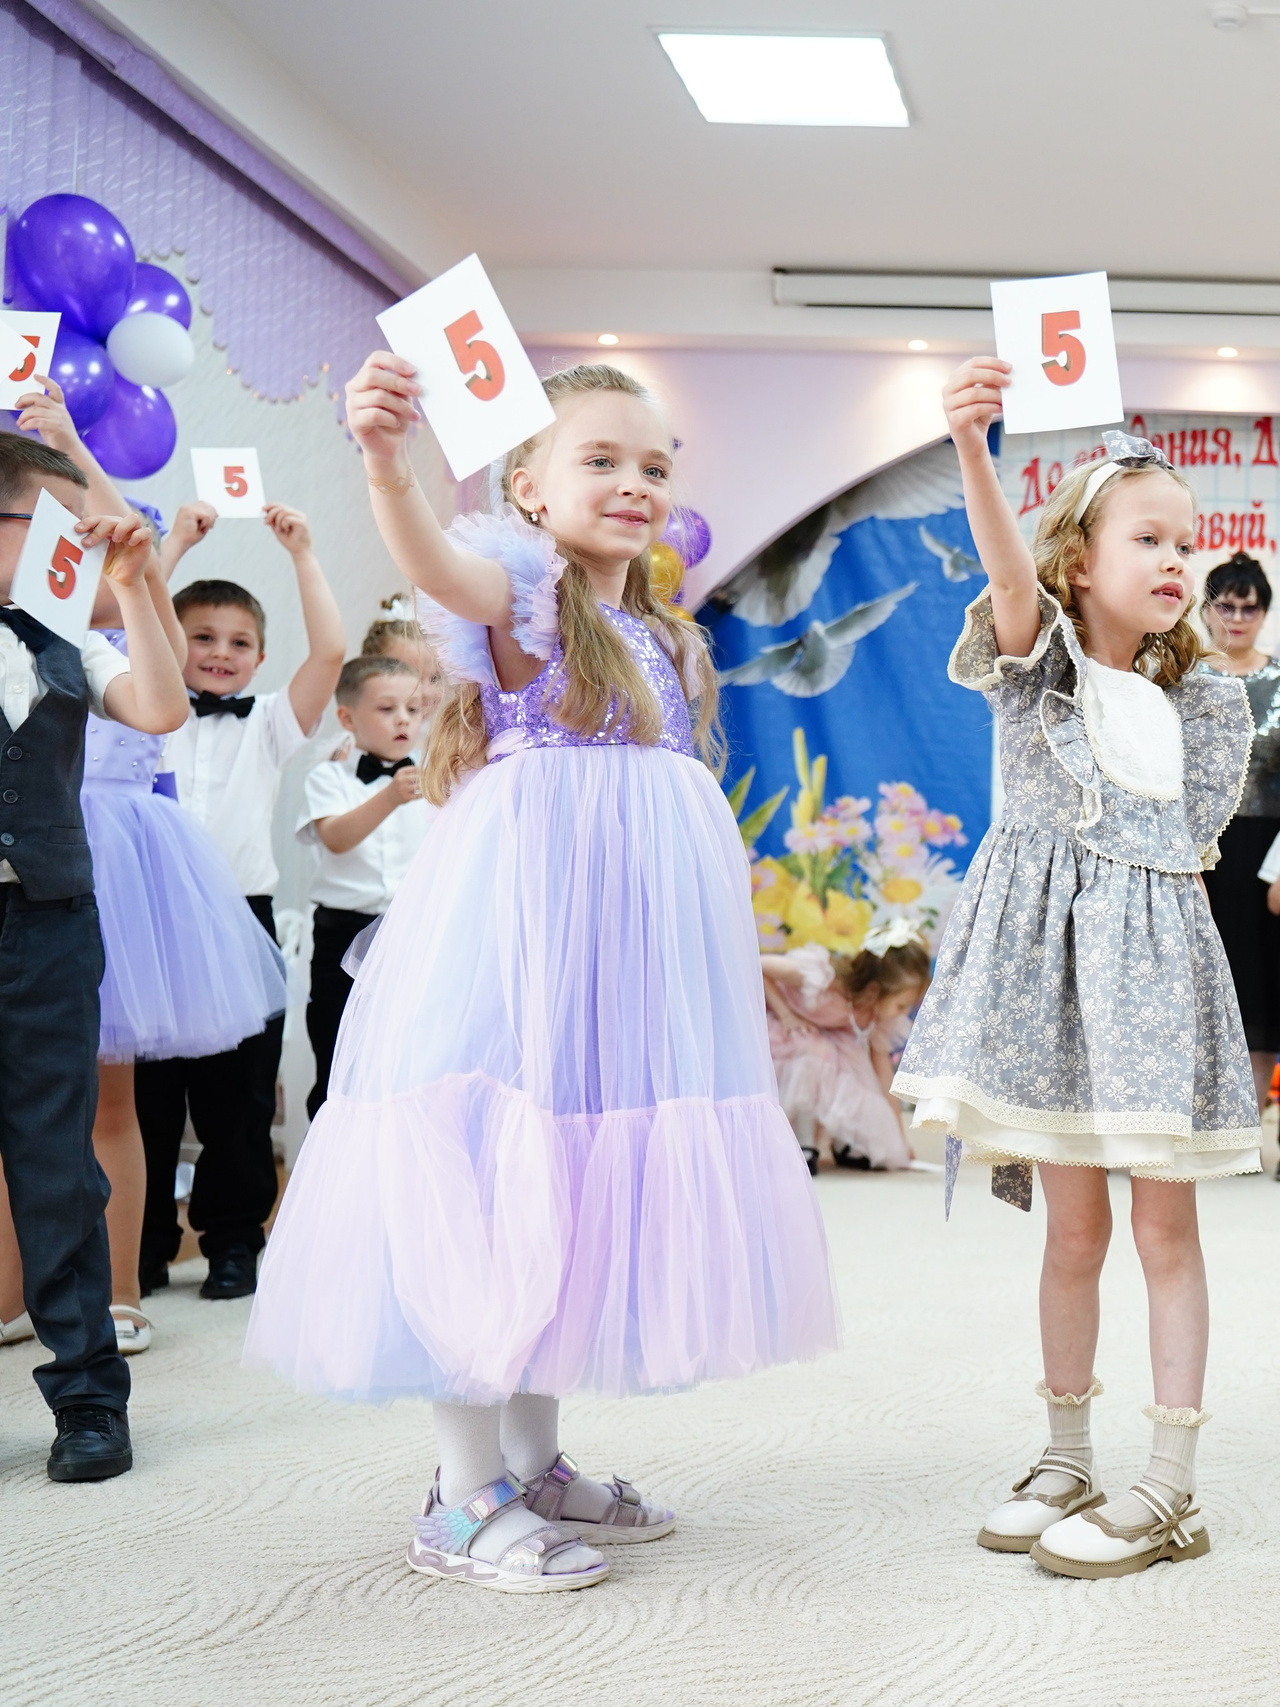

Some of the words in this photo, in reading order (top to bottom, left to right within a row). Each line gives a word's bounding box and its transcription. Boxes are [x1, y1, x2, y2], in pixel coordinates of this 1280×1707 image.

[444, 310, 505, 401] 5
[1041, 309, 1087, 386] 5
[223, 465, 248, 497] 5
[47, 535, 83, 601] 5
